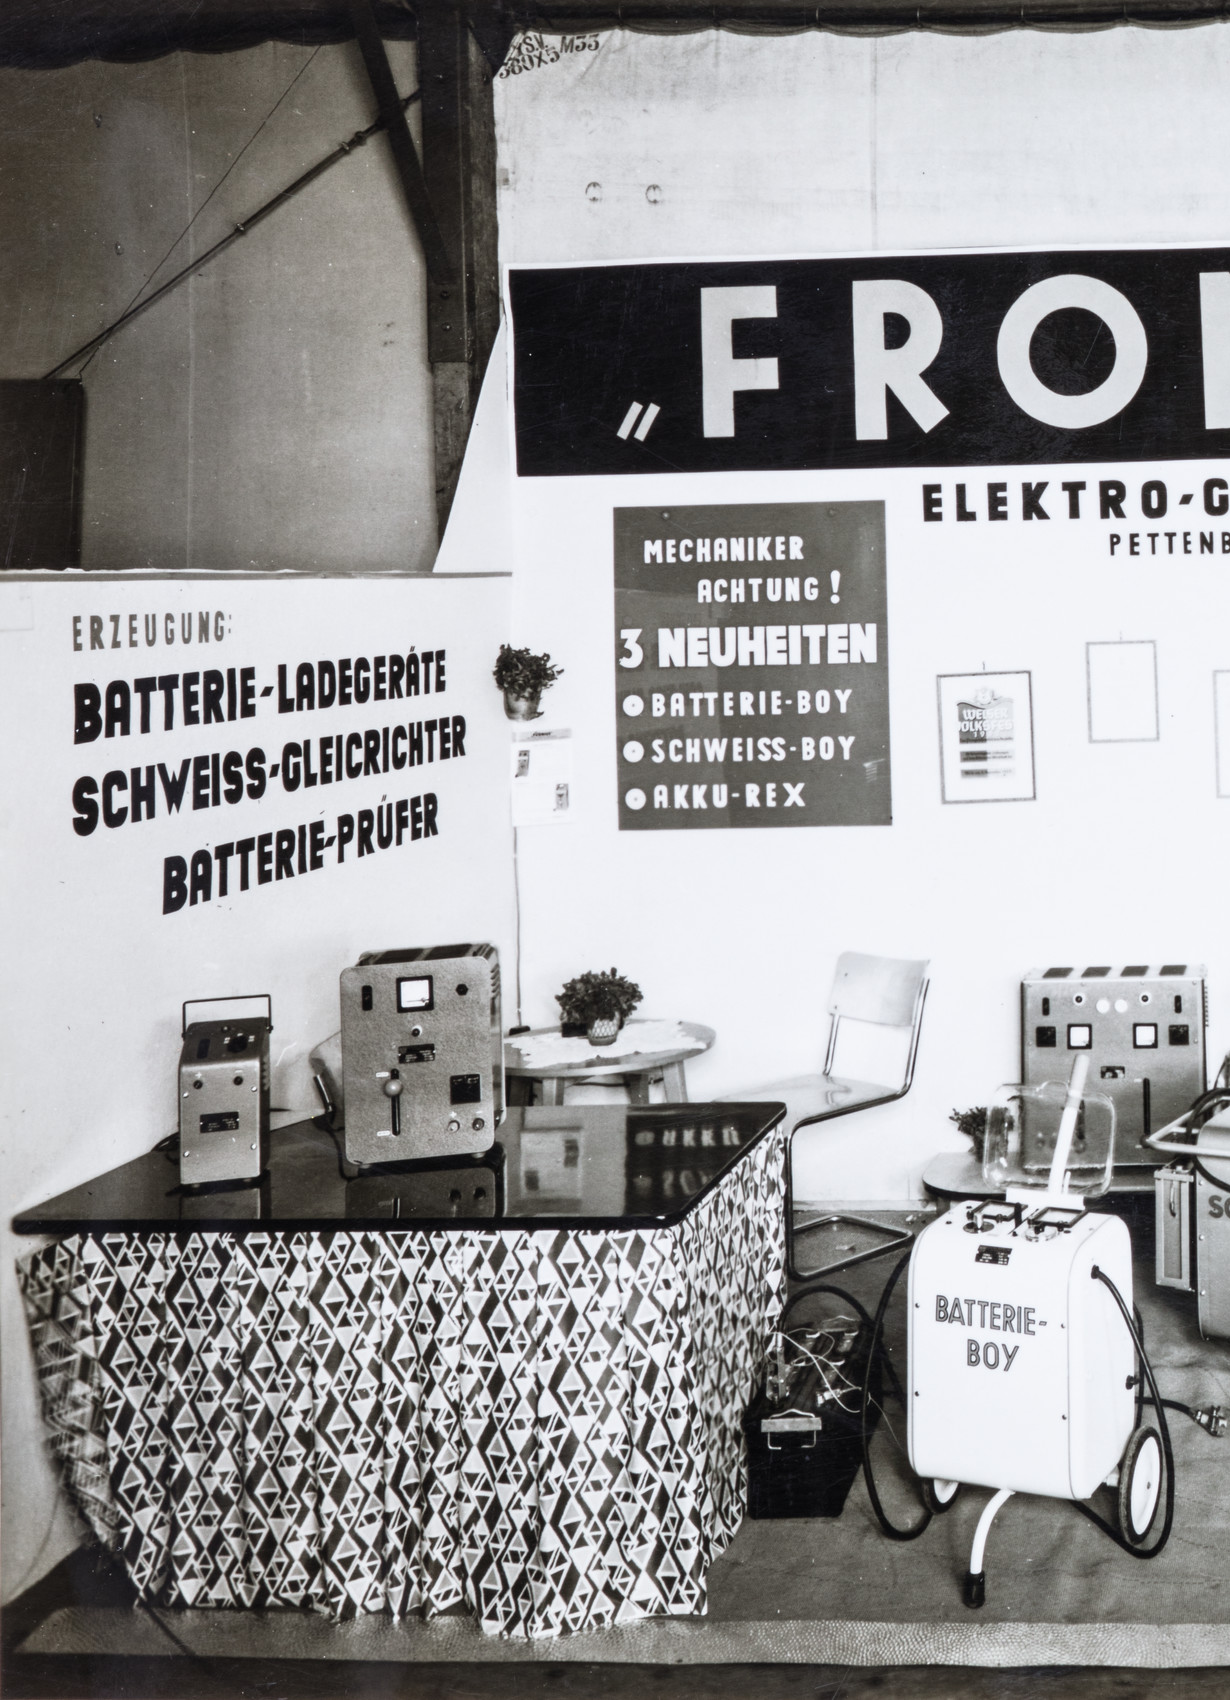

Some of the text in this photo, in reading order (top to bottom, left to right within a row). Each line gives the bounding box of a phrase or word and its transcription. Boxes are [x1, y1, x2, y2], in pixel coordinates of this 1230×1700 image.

[643, 535, 804, 564] MECHANIKER
[72, 610, 232, 652] ERZEUGUNG:
[619, 622, 878, 669] 3 NEUHEITEN
[73, 646, 447, 745] BATTERIE-LADEGERÄTE
[651, 688, 853, 717] BATTERIE-BOY
[651, 735, 856, 764] SCHWEISS-BOY
[72, 715, 467, 836] SCHWEISS-GLEICRICHTER
[653, 782, 806, 809] AKKU-REX
[162, 793, 439, 915] BATTERIE-PRÜFER
[935, 1294, 1048, 1336] BATTERIE-
[967, 1338, 1020, 1372] BOY
